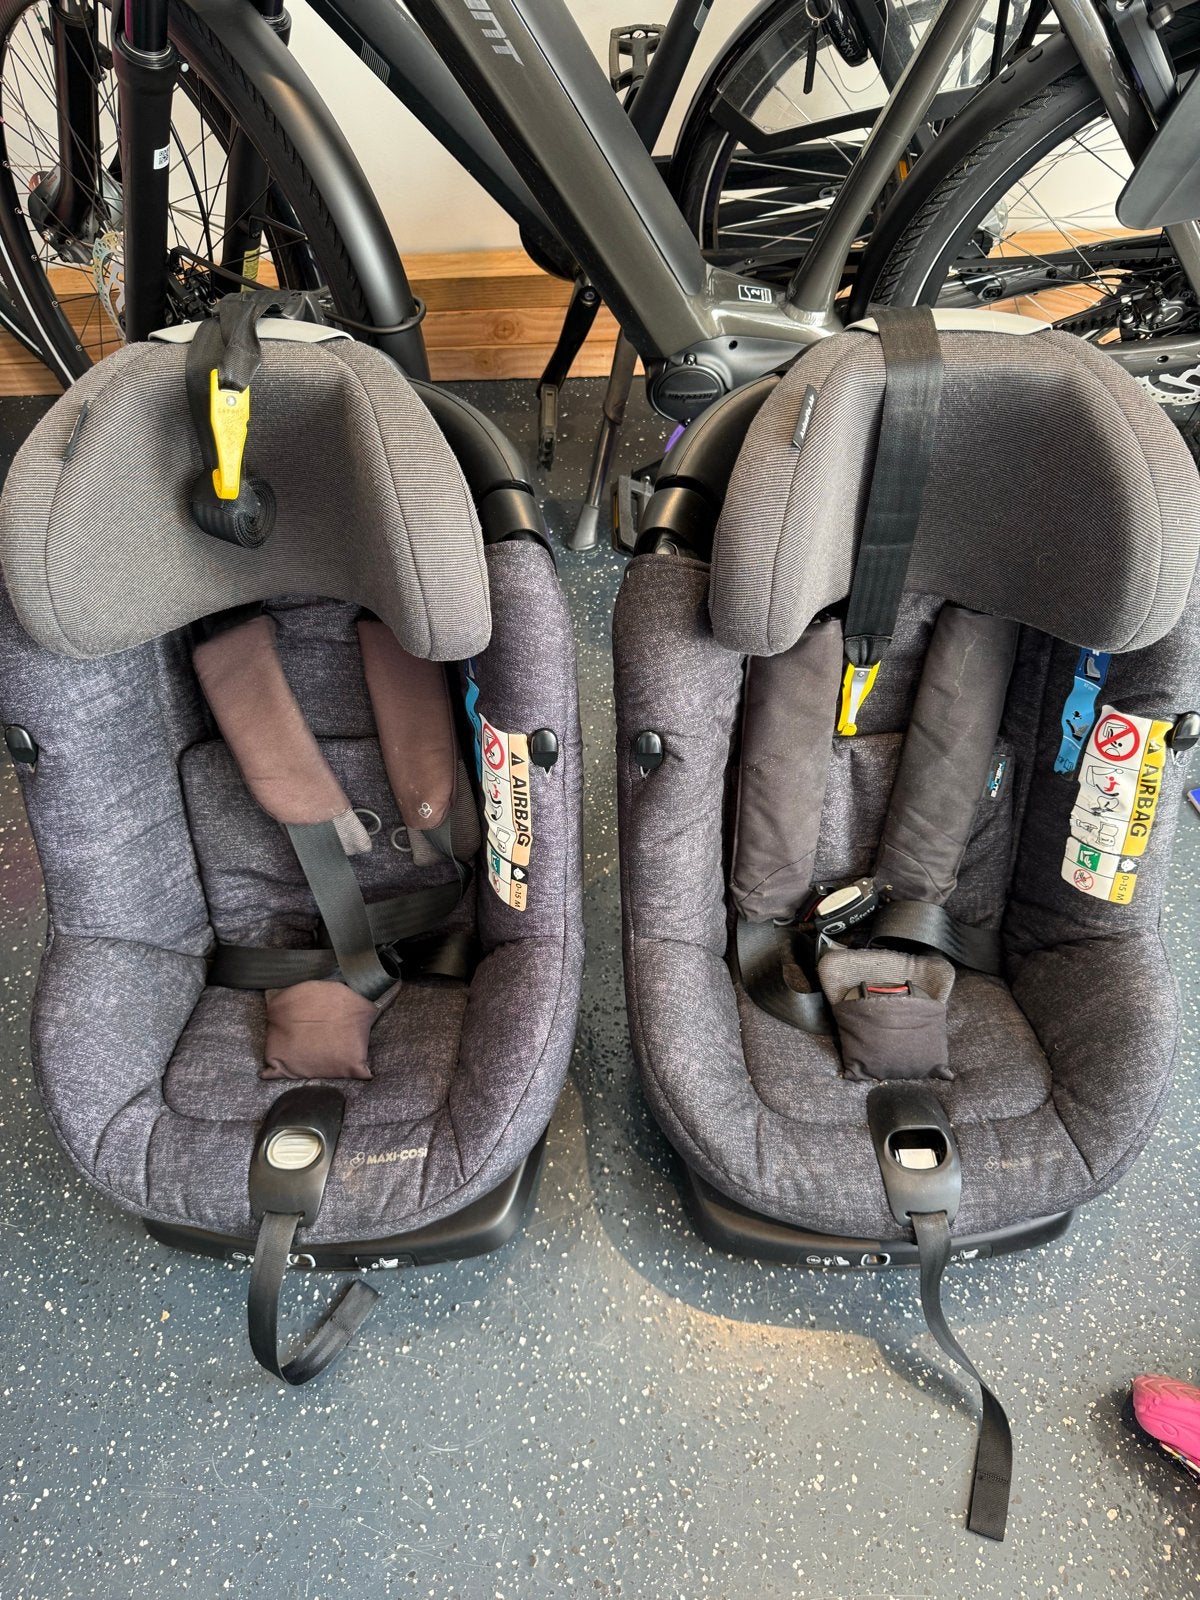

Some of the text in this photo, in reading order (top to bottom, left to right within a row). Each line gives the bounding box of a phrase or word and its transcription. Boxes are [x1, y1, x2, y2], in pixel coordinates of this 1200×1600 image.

[512, 775, 531, 848] AIRBAG
[1130, 764, 1159, 838] AIRBAG
[514, 883, 522, 908] 0-15 M
[1116, 875, 1130, 901] 0-15 M
